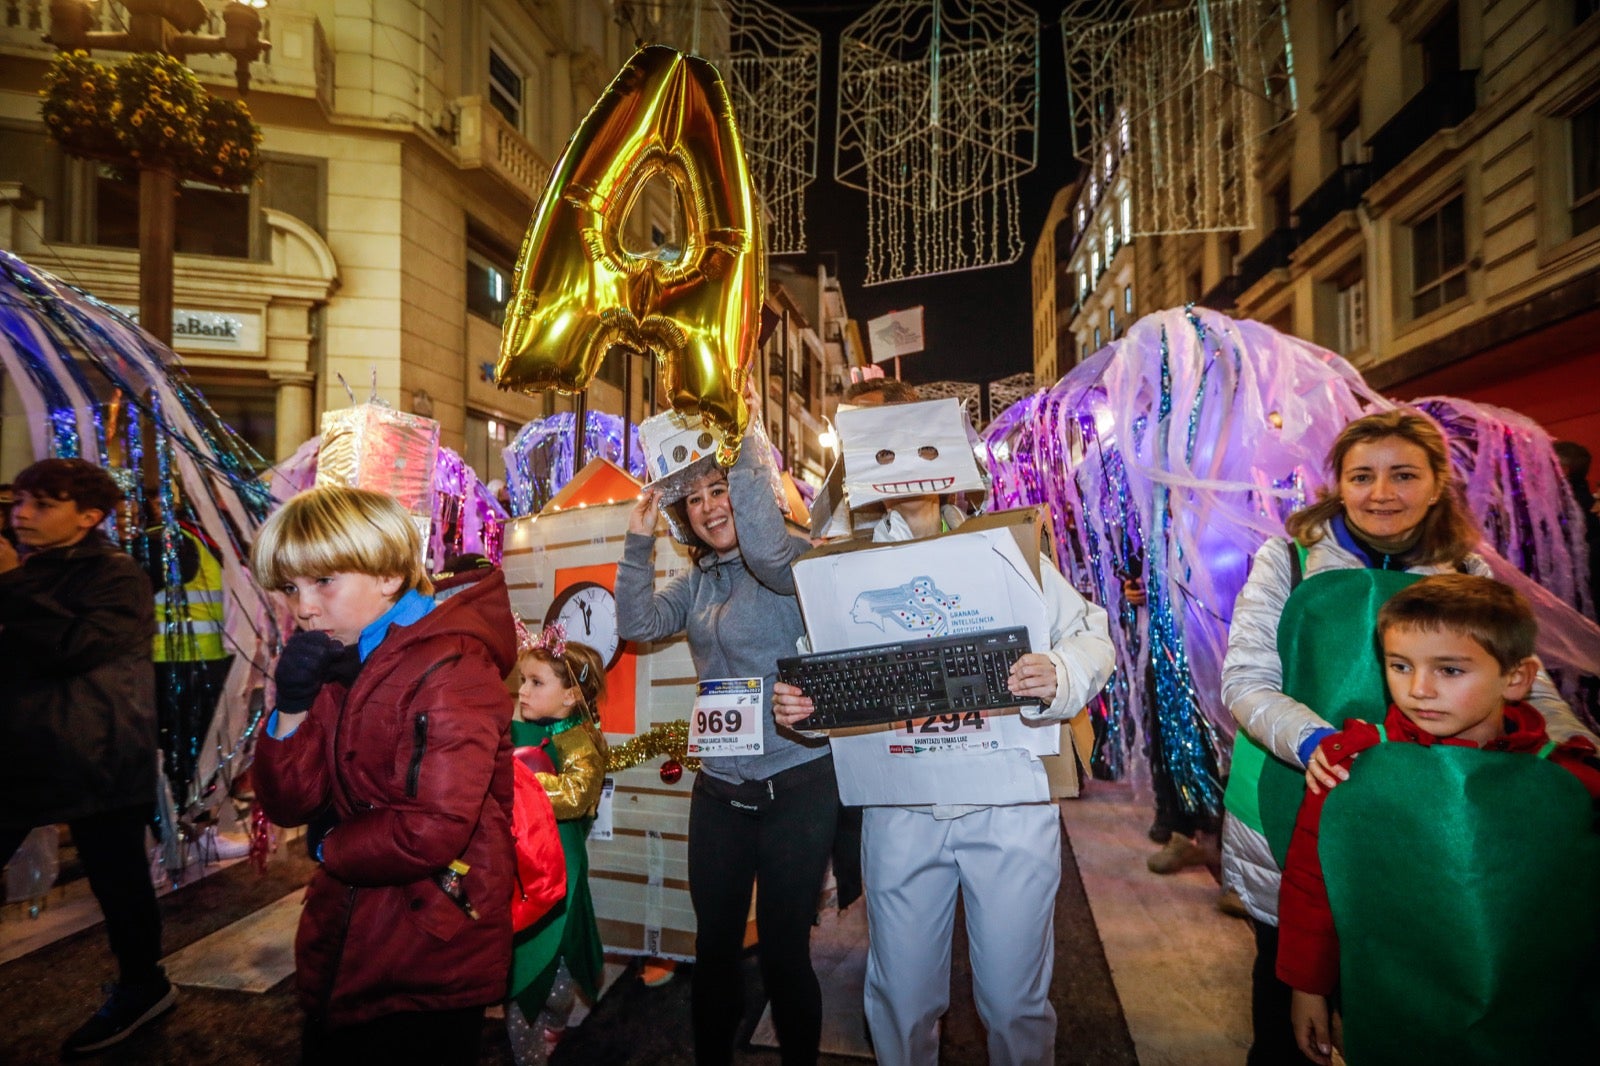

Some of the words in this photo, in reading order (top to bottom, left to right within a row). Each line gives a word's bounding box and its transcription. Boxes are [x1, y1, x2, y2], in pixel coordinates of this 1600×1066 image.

[950, 609, 980, 618] GRANADA
[951, 616, 995, 626] INTELIGENCIA
[697, 710, 742, 733] 969
